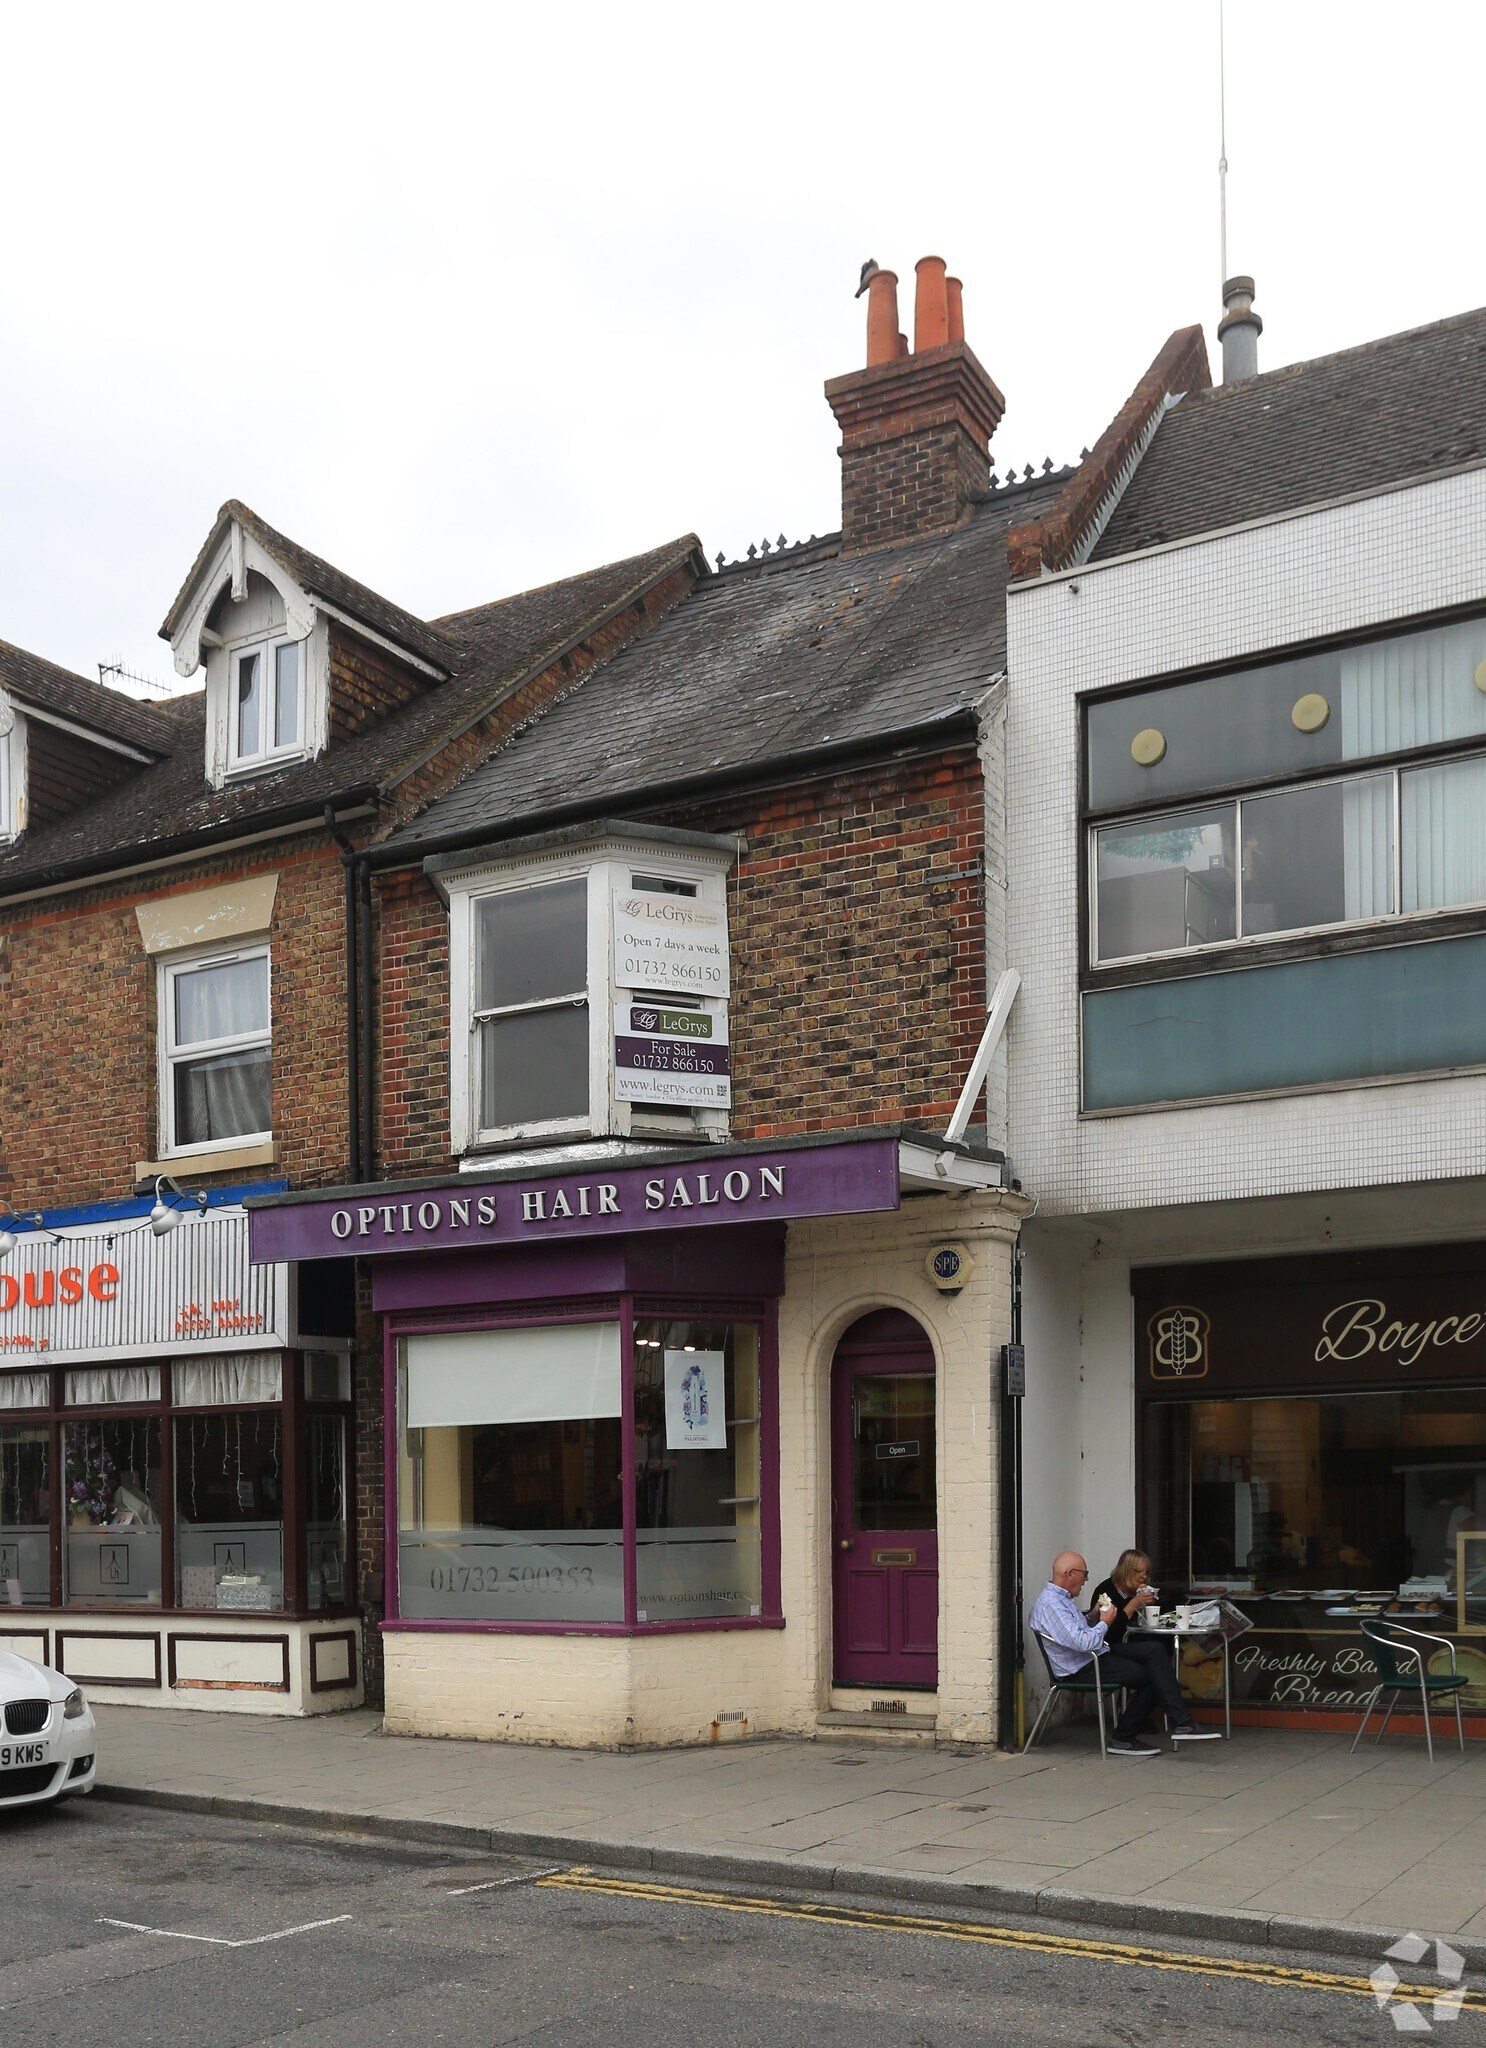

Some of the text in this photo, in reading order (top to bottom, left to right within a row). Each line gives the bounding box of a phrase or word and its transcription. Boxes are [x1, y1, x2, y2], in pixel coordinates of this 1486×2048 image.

[646, 903, 693, 925] LeGrys
[624, 933, 721, 955] Open 7 days a week
[625, 958, 721, 982] 01732 866150
[645, 977, 704, 989] www.legrys.com
[663, 1014, 708, 1036] LeGrys
[651, 1041, 697, 1057] For Sale
[633, 1054, 714, 1073] 01732 866150
[620, 1078, 714, 1097] www.legrys.com
[331, 1165, 787, 1238] OPTIONS HAIR SALON
[1315, 1299, 1486, 1365] Boyce
[889, 1446, 906, 1455] Open
[430, 1566, 500, 1593] 01732
[1235, 1645, 1418, 1679] Freshly Bad
[15, 1744, 44, 1764] KWS
